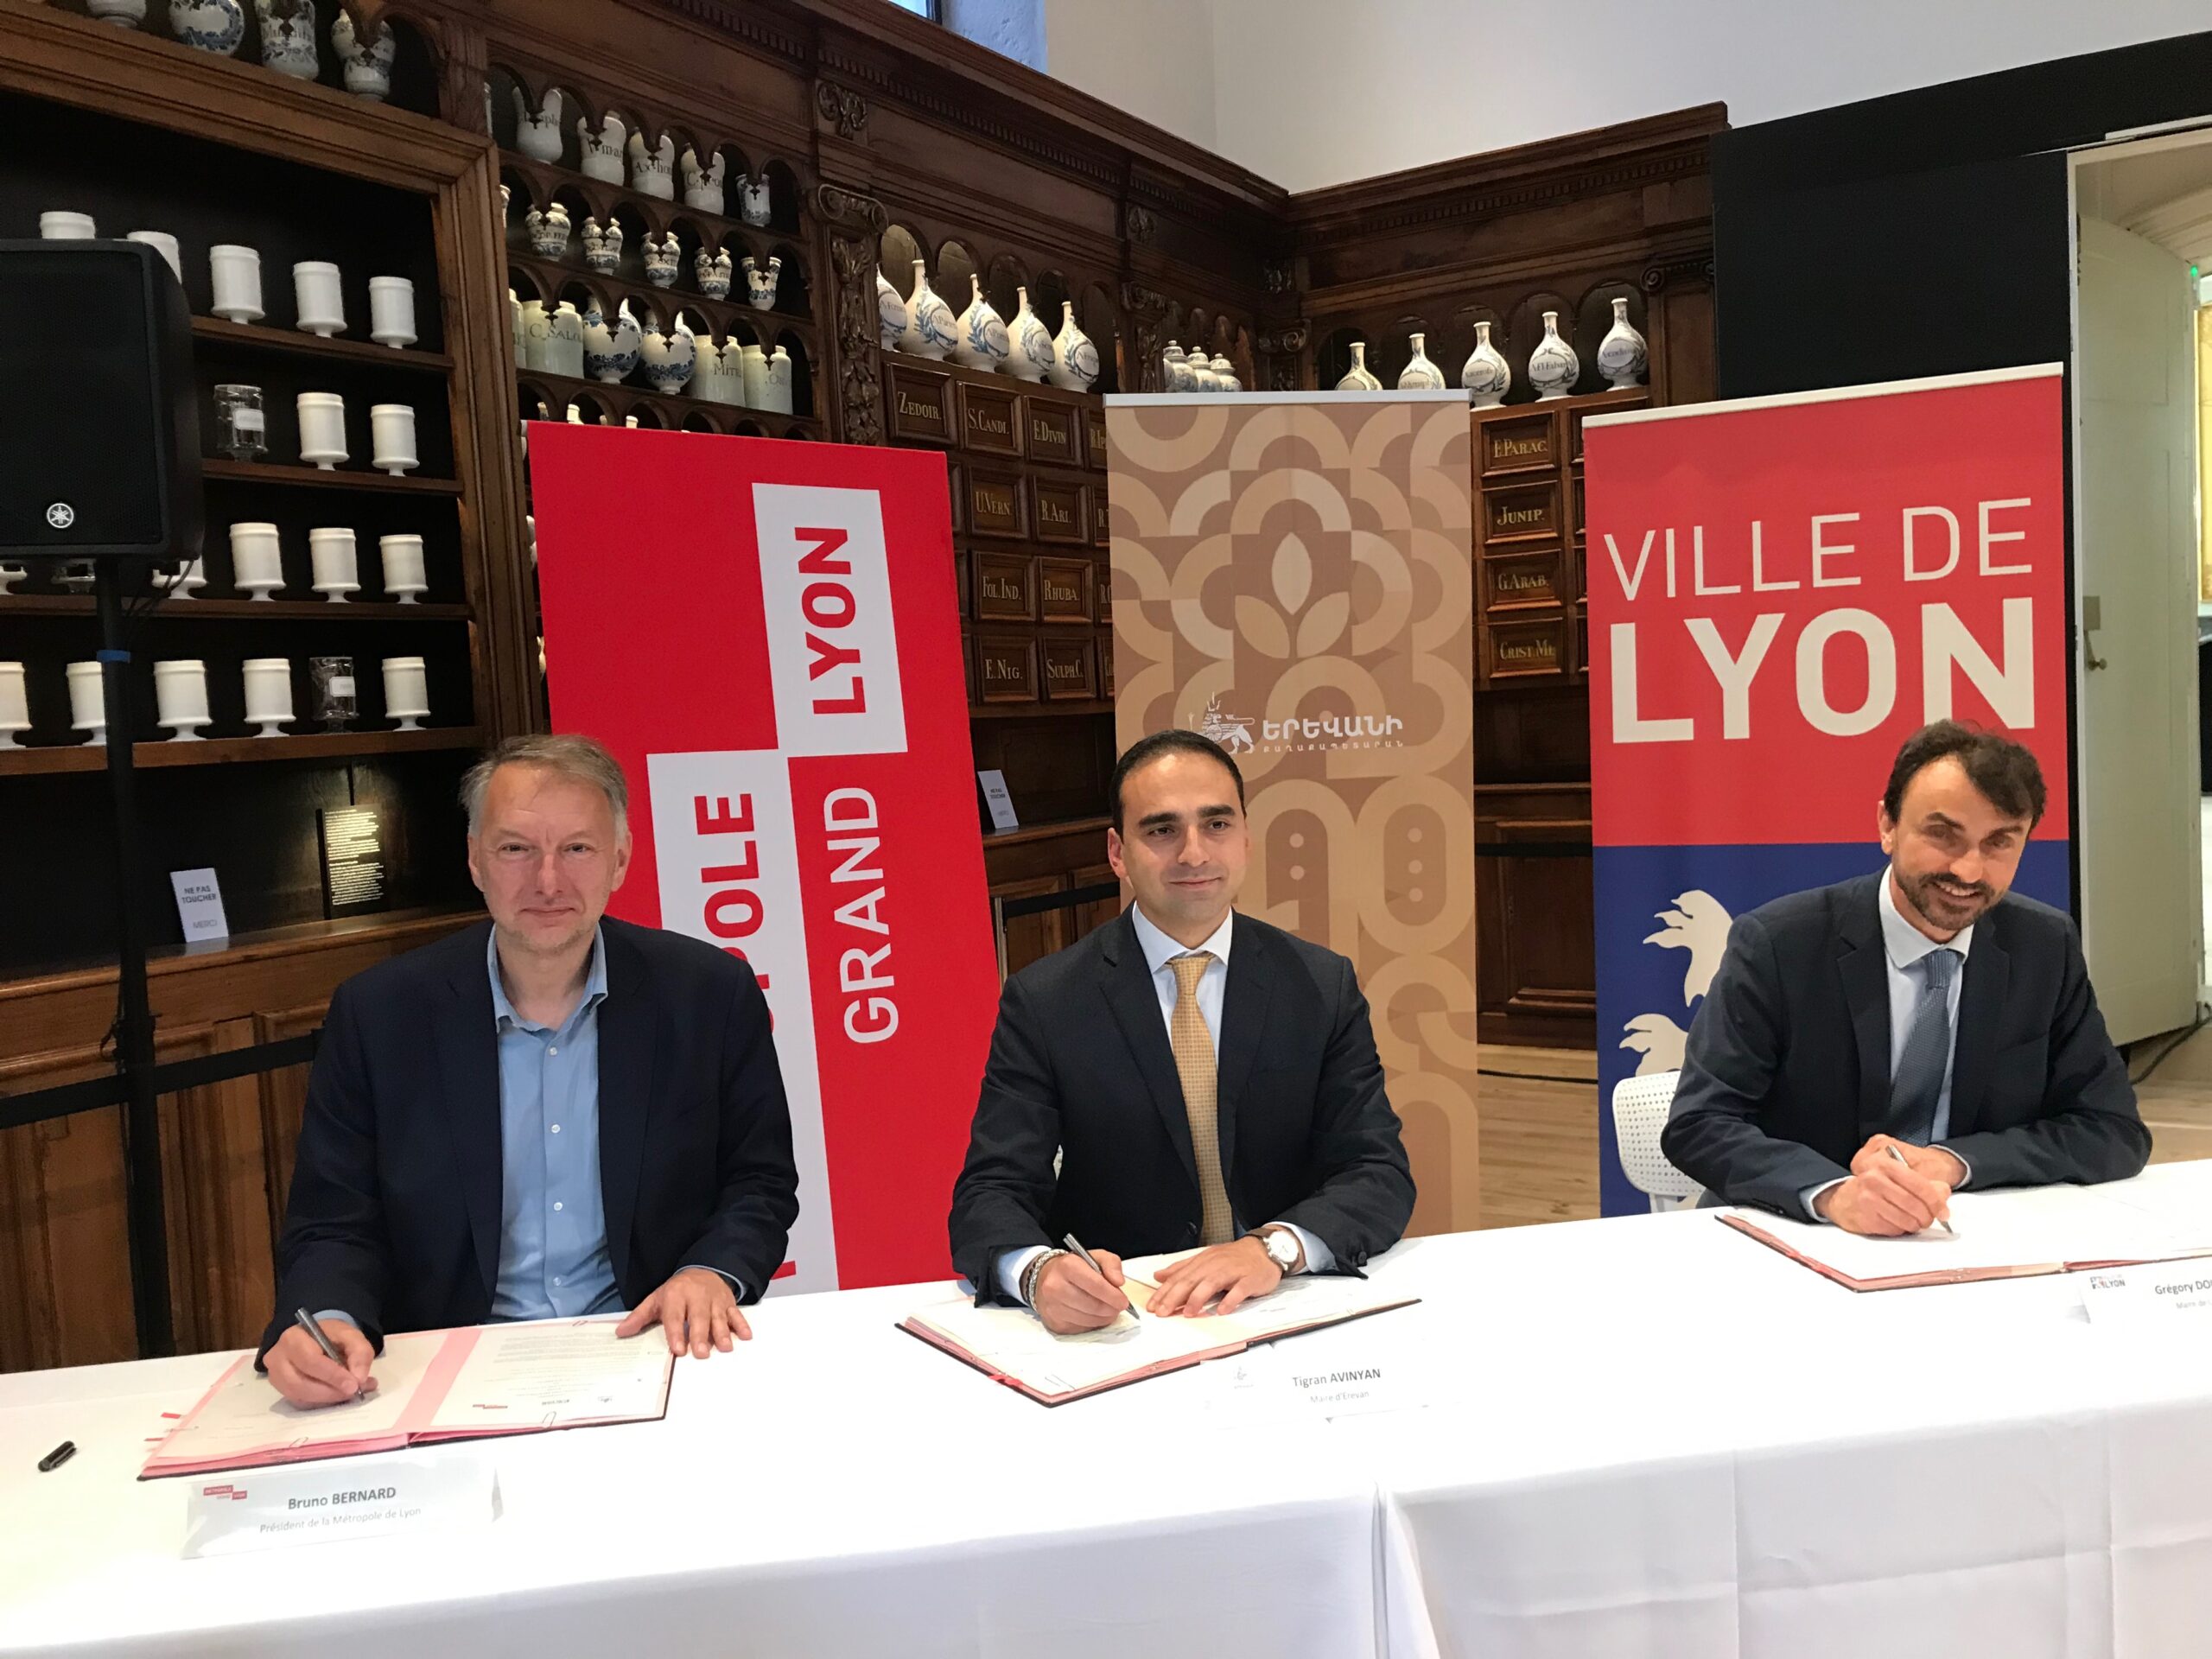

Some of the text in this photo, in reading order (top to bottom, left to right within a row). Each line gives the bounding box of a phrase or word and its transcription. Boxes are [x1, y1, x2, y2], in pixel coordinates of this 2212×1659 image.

[898, 391, 942, 420] ZEDOIR.
[1497, 505, 1544, 526] JUNIP.
[1604, 497, 2032, 601] VILLE DE
[1610, 597, 2035, 744] LYON
[1262, 715, 1403, 741] ԵՐԵՎԱՆԻ
[794, 526, 899, 1044] GRAND LYON
[181, 893, 217, 904] TOUCHER
[2155, 1283, 2193, 1295] Grégory
[1293, 1369, 1381, 1388] Tigran AVINYAN
[288, 1487, 397, 1510] Bruno BERNARD
[260, 1508, 422, 1533] Président de la Métropole de Lyon
